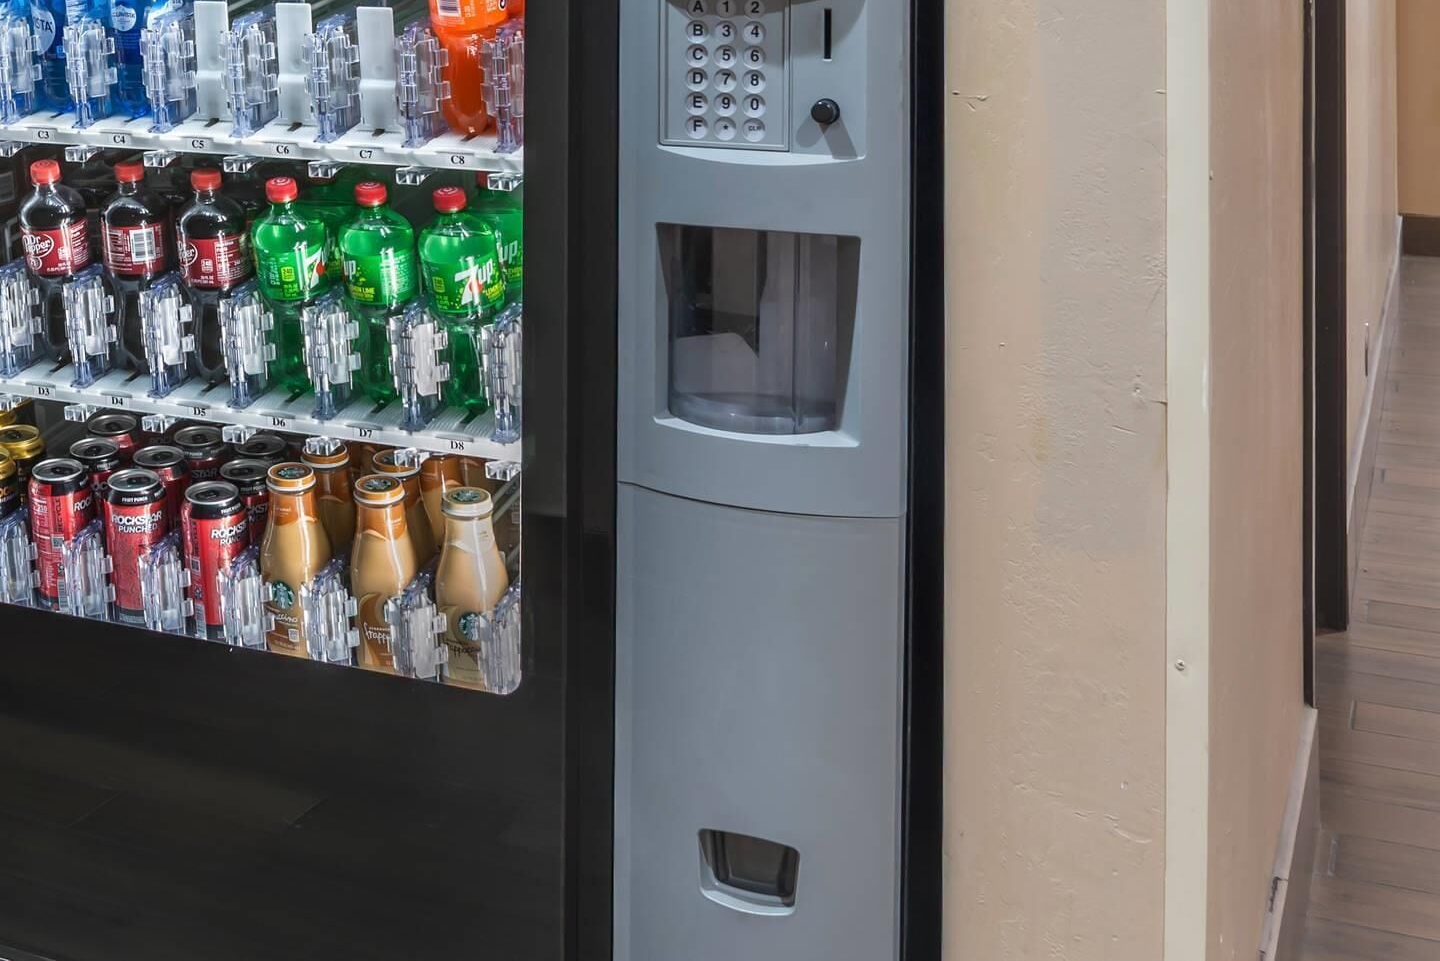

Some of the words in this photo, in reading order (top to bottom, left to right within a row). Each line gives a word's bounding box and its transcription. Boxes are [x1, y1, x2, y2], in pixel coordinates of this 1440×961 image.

[693, 0, 704, 12] A
[722, 1, 728, 12] 1
[751, 1, 759, 13] 2
[693, 24, 703, 36] B
[722, 24, 730, 37] 3
[750, 26, 760, 37] 4
[692, 48, 703, 60] C
[722, 49, 730, 61] 5
[750, 50, 760, 62] 6
[692, 72, 703, 84] D
[722, 72, 730, 85] 7
[750, 74, 760, 86] 8
[693, 96, 702, 108] E
[722, 97, 730, 109] 9
[750, 98, 759, 110] 0
[693, 120, 703, 132] F
[38, 130, 49, 140] C3
[113, 134, 125, 144] C4
[192, 140, 204, 149] C5
[276, 144, 289, 154] C6
[360, 150, 372, 159] C7
[450, 154, 464, 164] C8
[38, 387, 50, 396] D3
[112, 396, 123, 406] D4
[194, 408, 206, 417] D5
[272, 418, 286, 428] D6
[360, 429, 372, 438] D7
[450, 440, 464, 450] D8
[112, 510, 162, 526] ROCKSTAR
[118, 522, 158, 534] PUNCHED
